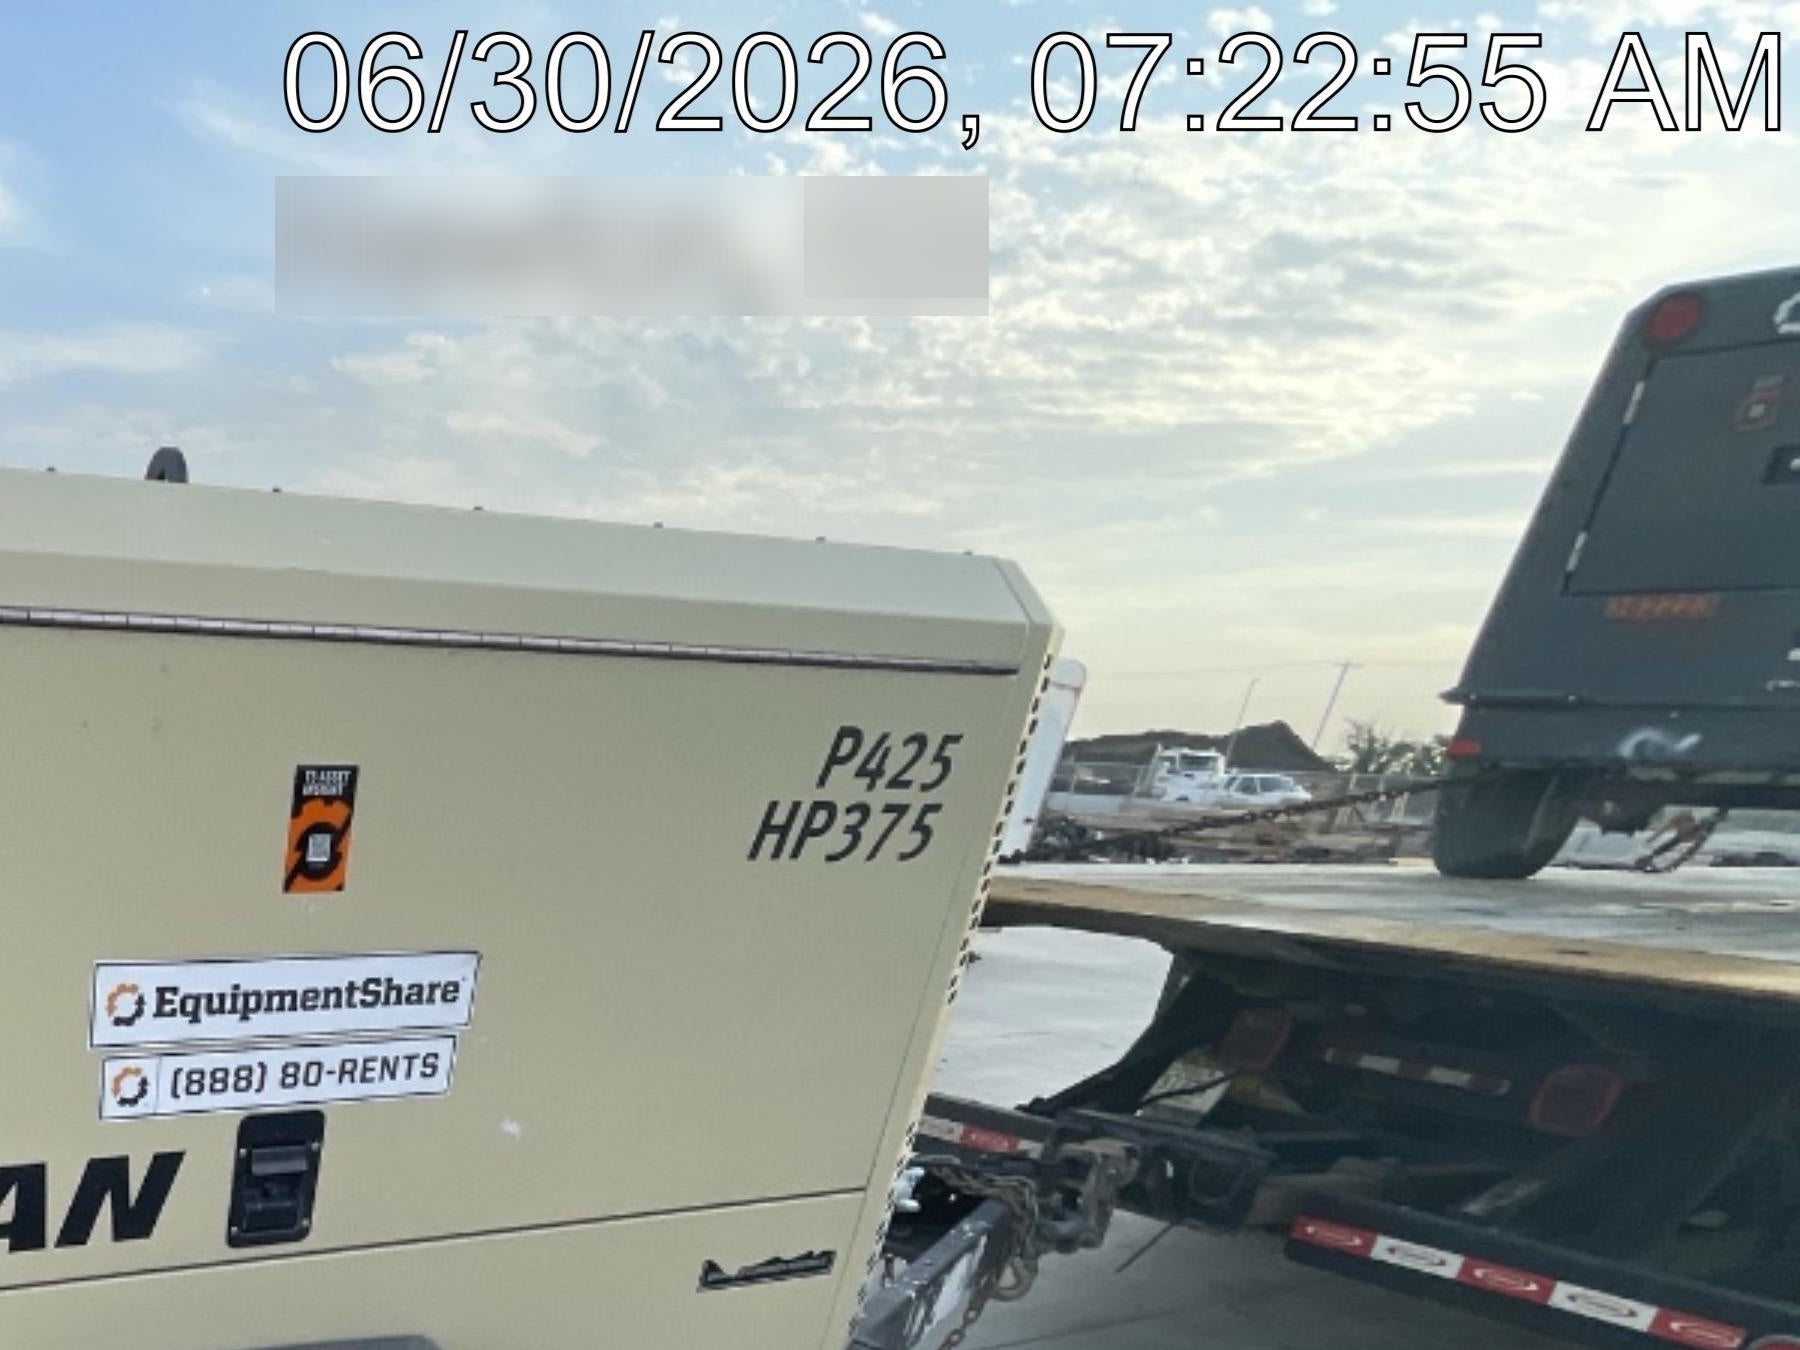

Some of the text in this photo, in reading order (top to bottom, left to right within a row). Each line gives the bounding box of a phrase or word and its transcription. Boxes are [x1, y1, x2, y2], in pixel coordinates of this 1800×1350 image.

[816, 725, 964, 793] P425
[747, 800, 943, 862] HP375
[152, 976, 461, 1025] EquipmentShare
[169, 1052, 441, 1099] (888) 80-RENTS
